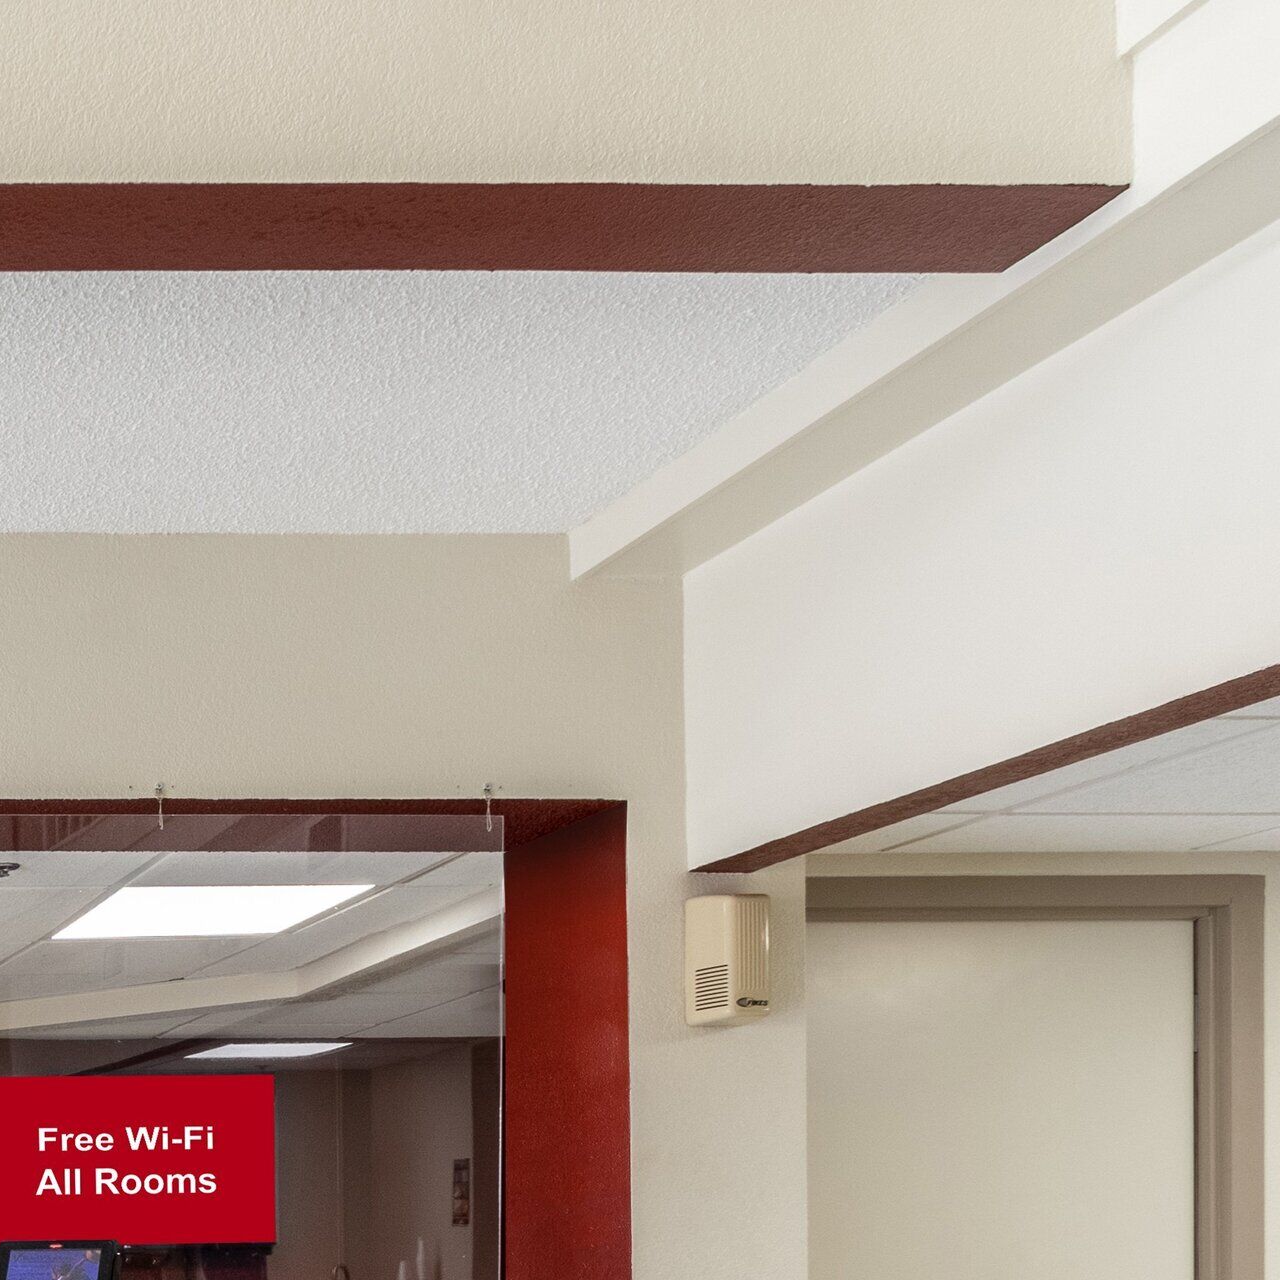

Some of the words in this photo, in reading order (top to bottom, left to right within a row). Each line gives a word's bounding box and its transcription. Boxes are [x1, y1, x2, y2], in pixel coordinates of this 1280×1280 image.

[38, 1127, 115, 1152] Free
[125, 1125, 215, 1150] Wi-Fi
[35, 1168, 82, 1196] All
[95, 1167, 217, 1195] Rooms
